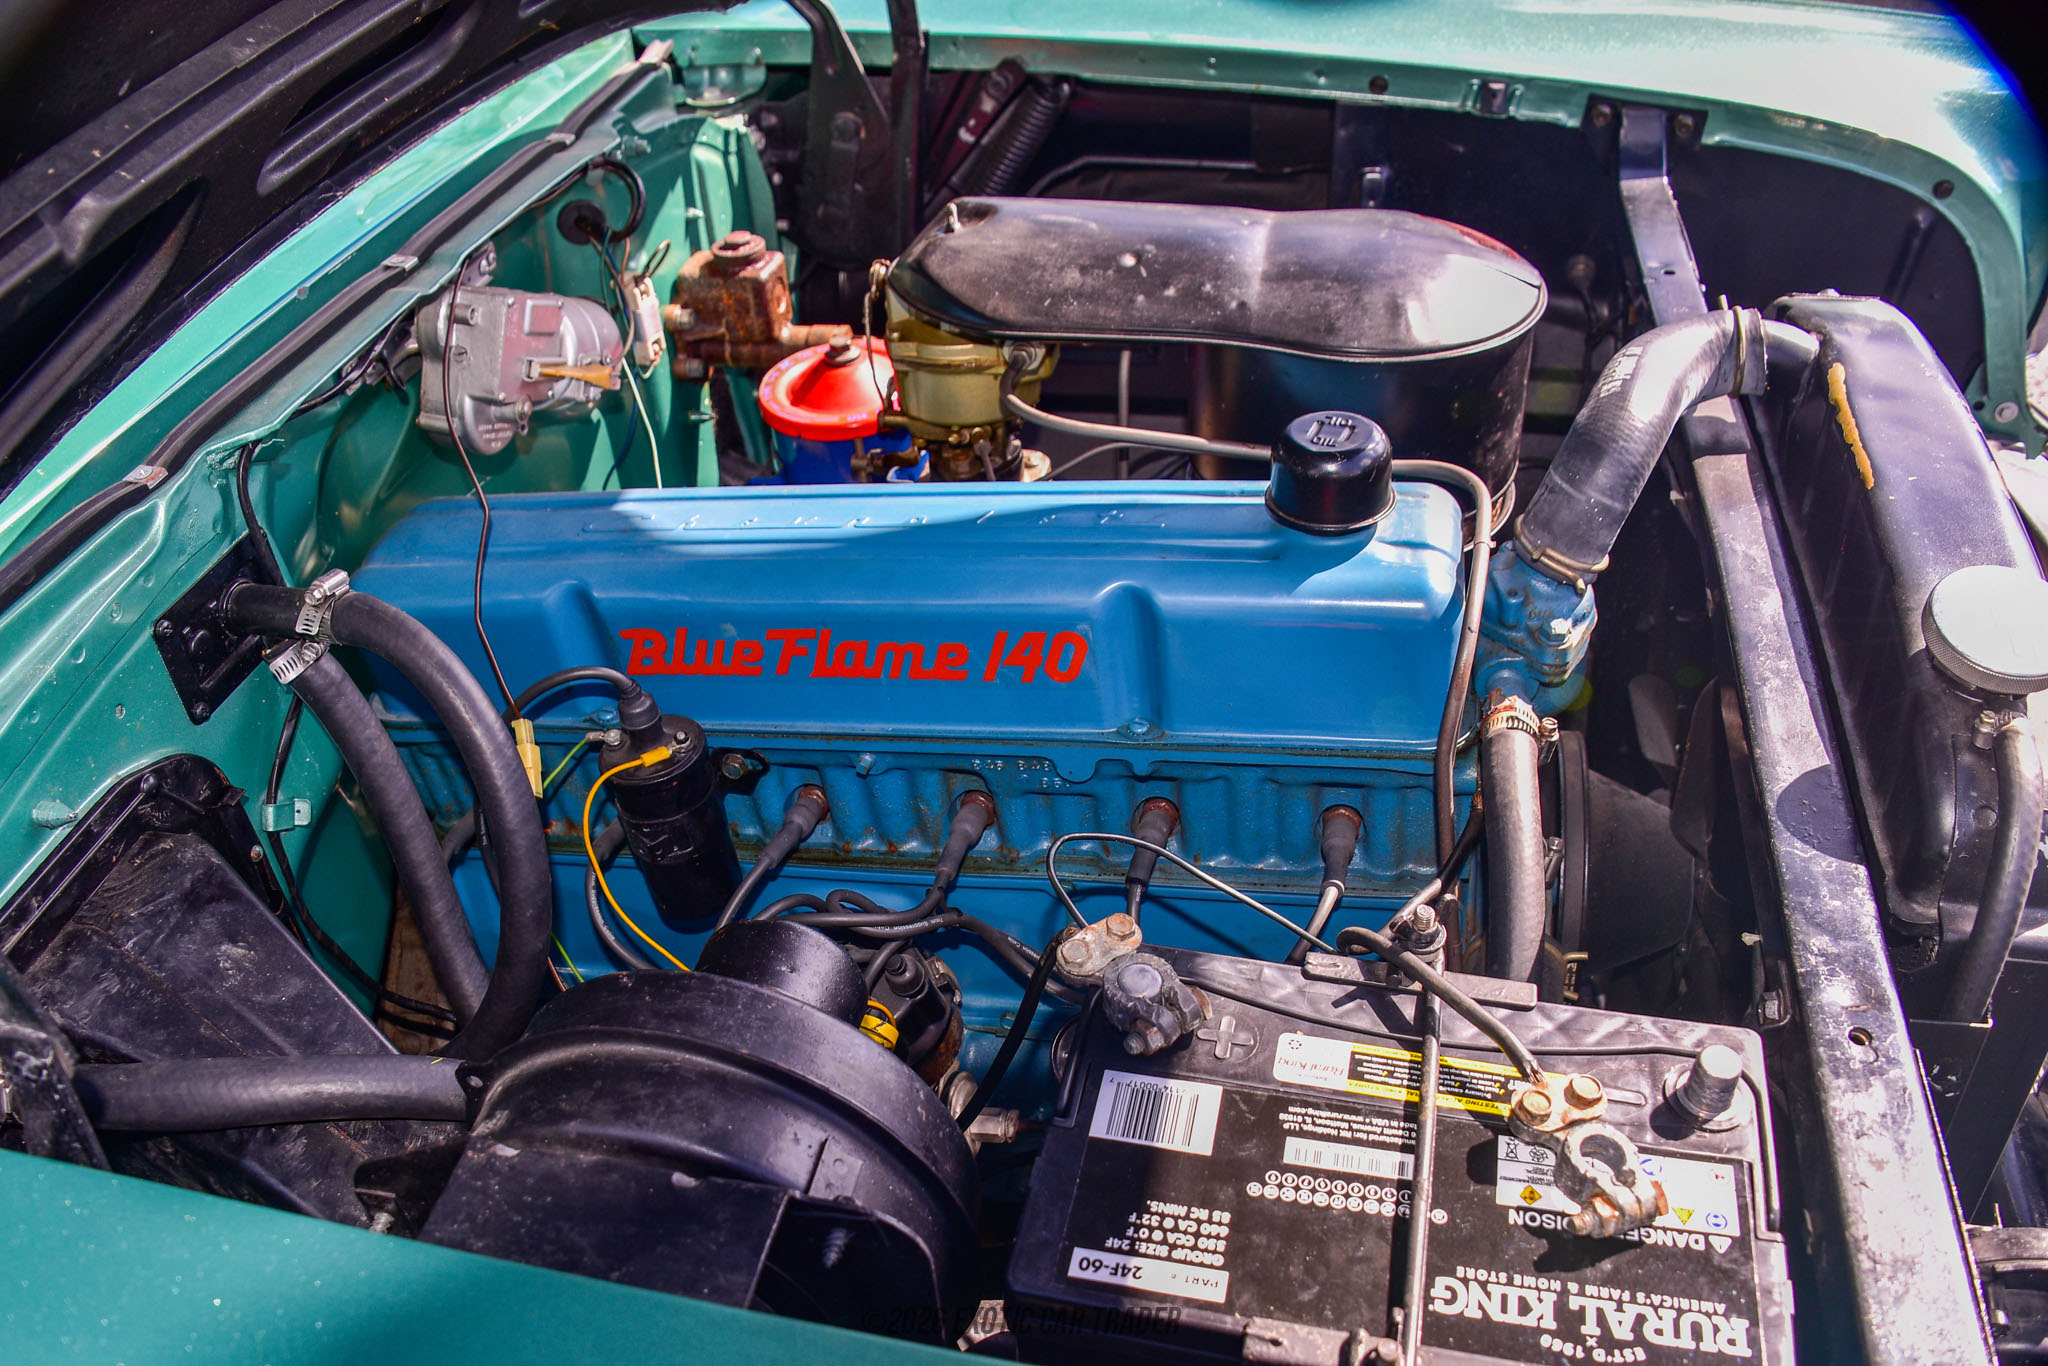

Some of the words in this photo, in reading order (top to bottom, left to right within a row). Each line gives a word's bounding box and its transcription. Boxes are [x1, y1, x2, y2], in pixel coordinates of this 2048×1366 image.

[982, 631, 1089, 683] 140
[1287, 1105, 1363, 1121] www.ruralking.com
[1370, 1117, 1388, 1126] USA
[1282, 1120, 1299, 1130] LLP
[1338, 1129, 1351, 1138] RK
[1368, 1133, 1416, 1146] anufactured
[1145, 1199, 1187, 1216] MINS.
[1189, 1206, 1209, 1220] RC
[1210, 1209, 1231, 1224] 85
[1176, 1218, 1198, 1233] CA
[1198, 1221, 1229, 1238] 660
[1104, 1235, 1131, 1250] 24F
[1164, 1230, 1195, 1247] CCA
[1623, 1224, 1706, 1251] DANGE
[1133, 1240, 1169, 1257] SIZE:
[1170, 1246, 1224, 1266] GROUP
[1077, 1256, 1144, 1280] 24F-60
[1454, 1265, 1508, 1283] STORE
[1183, 1274, 1218, 1288] PART
[1511, 1273, 1561, 1291] HOME
[1565, 1281, 1579, 1294] &
[1583, 1284, 1630, 1301] FARM
[1426, 1276, 1561, 1329] KING
[1634, 1291, 1726, 1314] AMERICA'S
[1568, 1296, 1751, 1357] RURAL
[1540, 1334, 1585, 1359] 1960
[1593, 1345, 1646, 1363] EST'D
